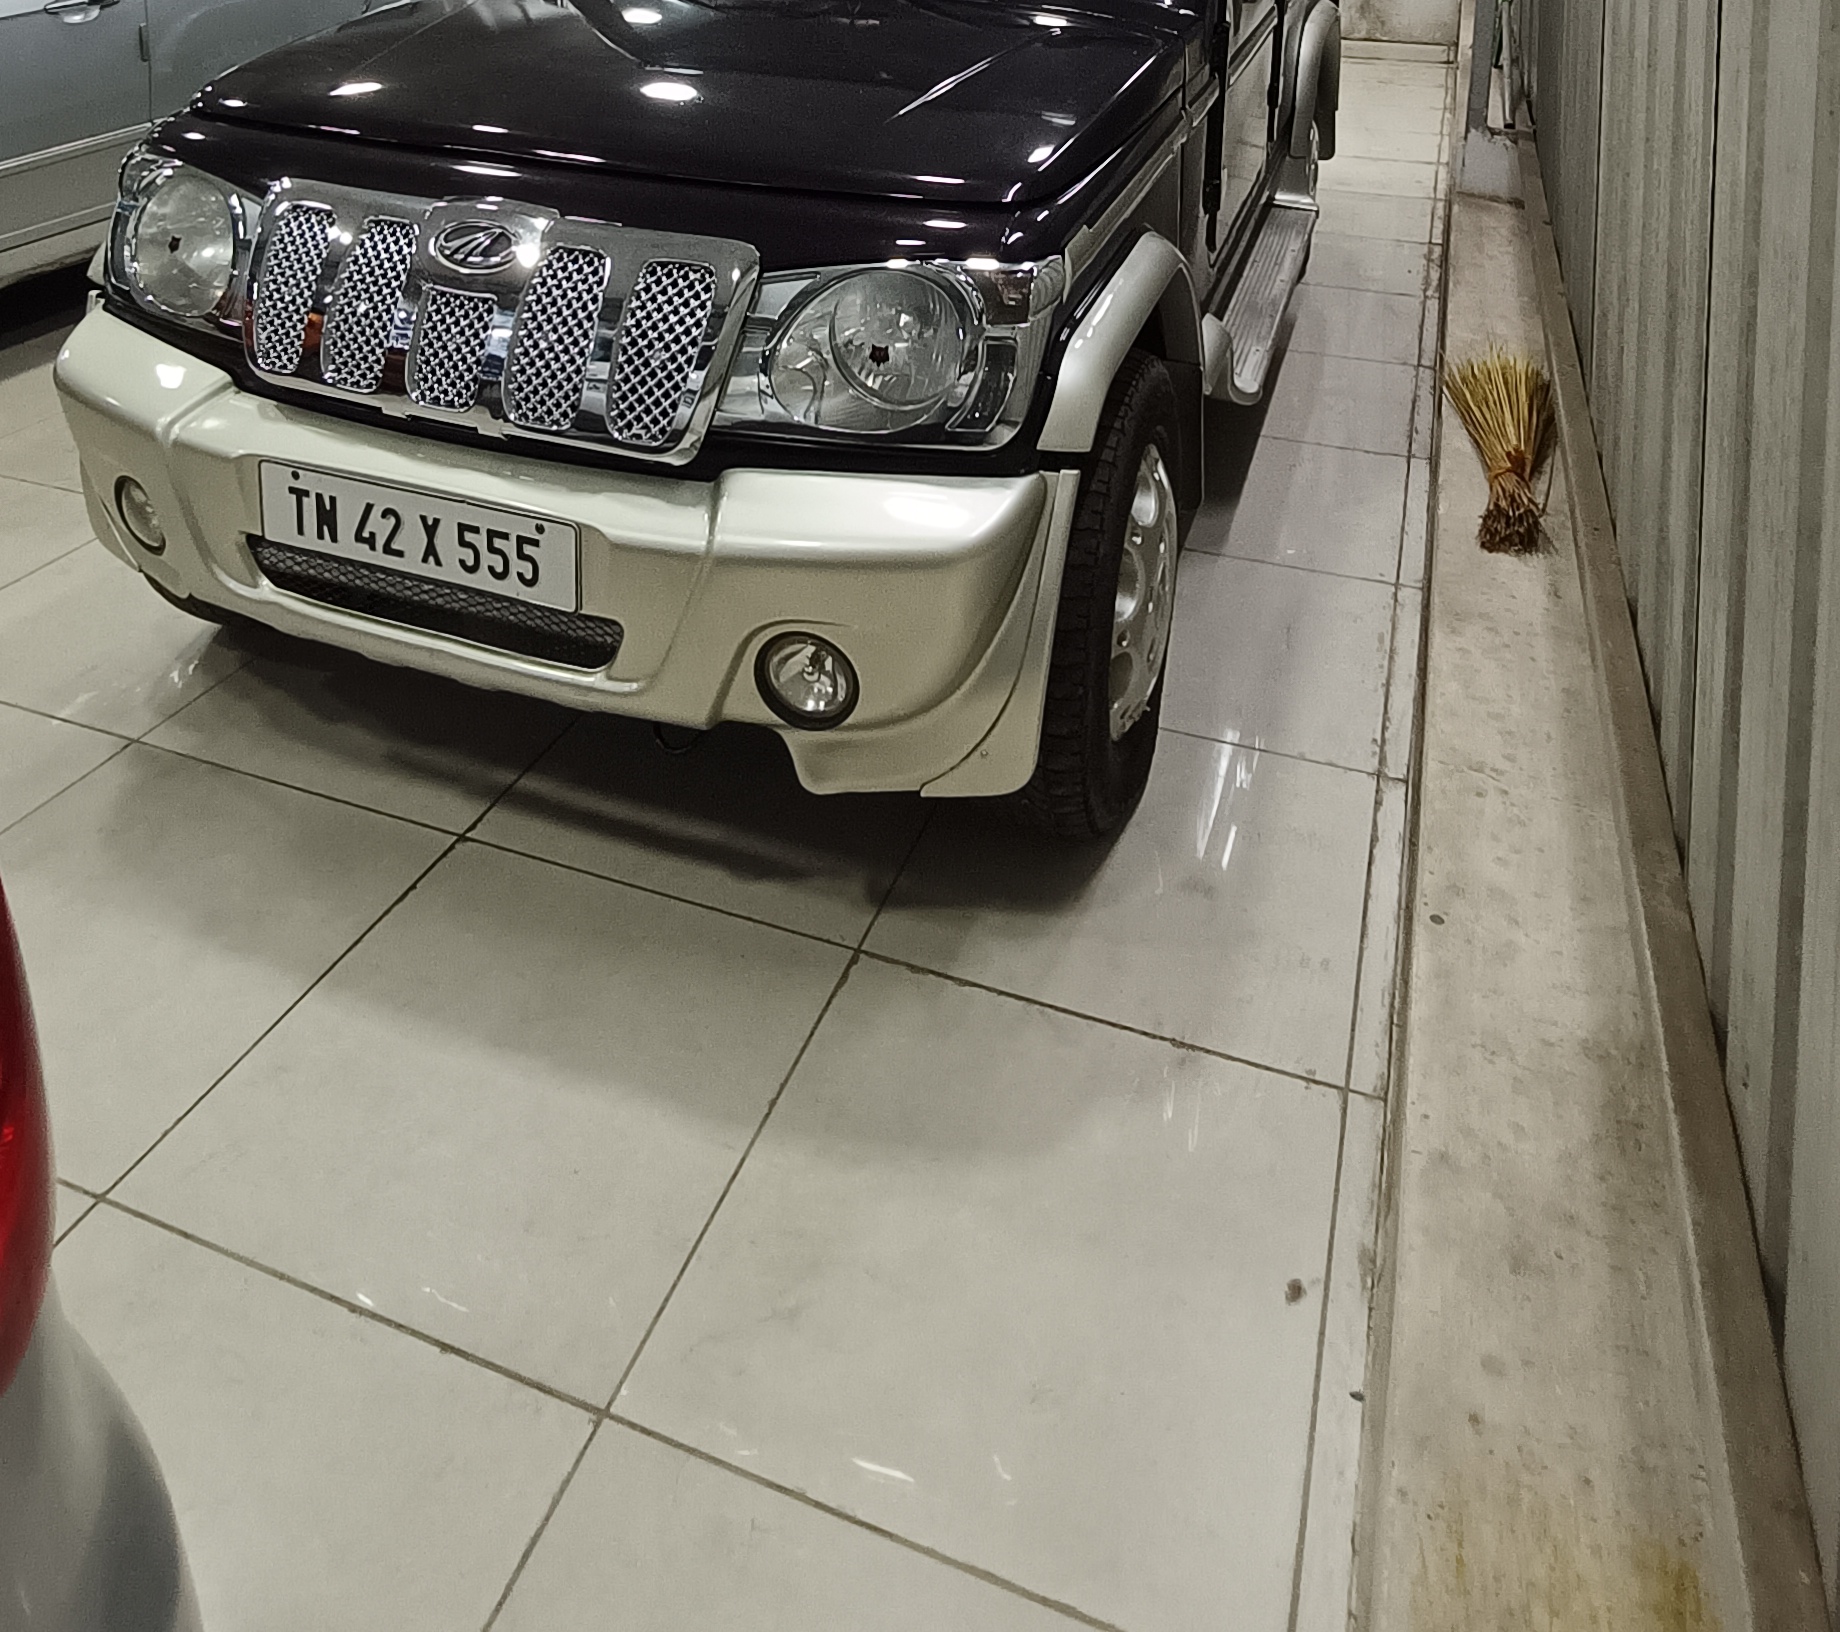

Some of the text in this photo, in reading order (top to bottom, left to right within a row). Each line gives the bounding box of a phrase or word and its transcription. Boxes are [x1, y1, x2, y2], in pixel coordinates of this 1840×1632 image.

[287, 485, 541, 588] TN 42 X 555
